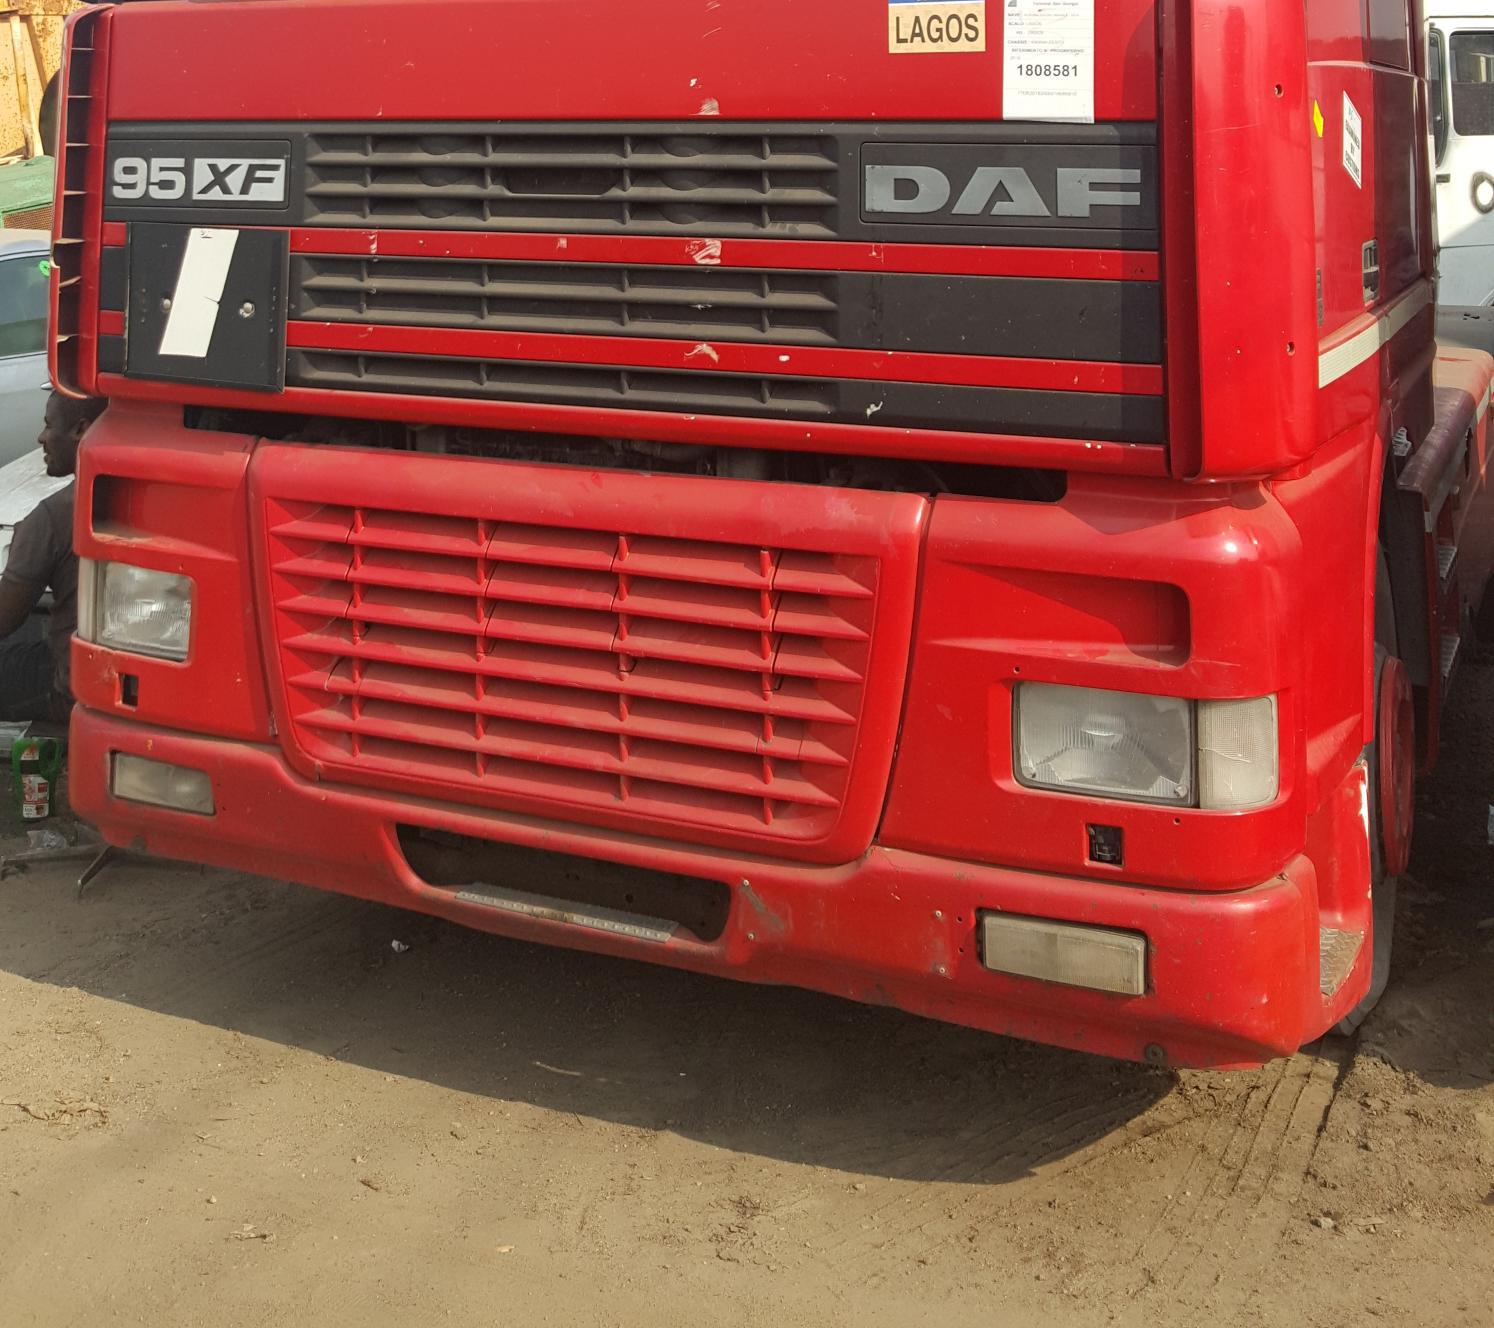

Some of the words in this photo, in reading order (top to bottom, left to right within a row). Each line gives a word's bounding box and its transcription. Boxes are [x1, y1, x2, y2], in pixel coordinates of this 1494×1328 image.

[895, 13, 980, 44] LAGOS
[1016, 64, 1078, 77] 1808581
[865, 164, 1141, 217] DAF
